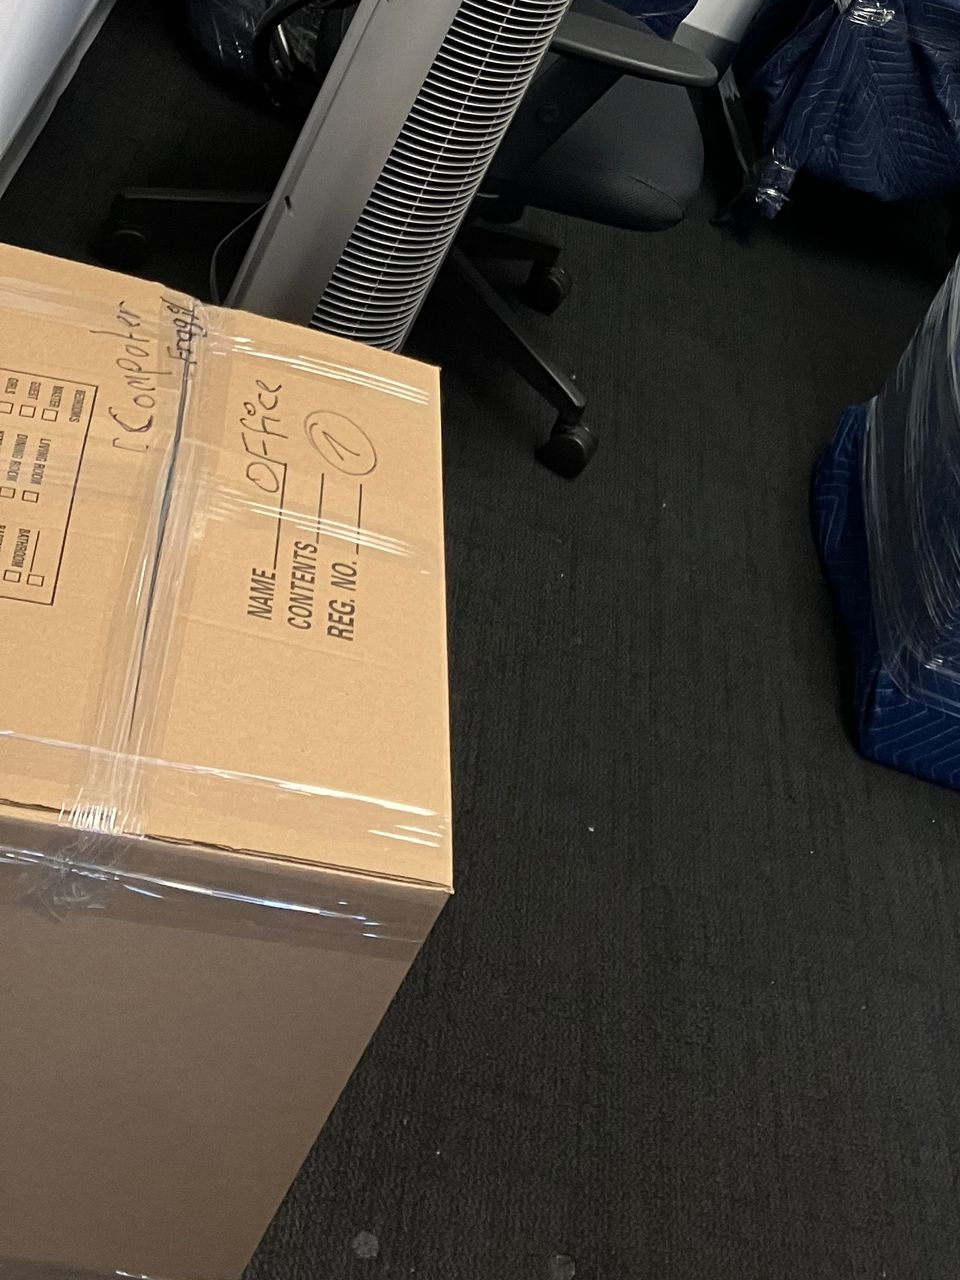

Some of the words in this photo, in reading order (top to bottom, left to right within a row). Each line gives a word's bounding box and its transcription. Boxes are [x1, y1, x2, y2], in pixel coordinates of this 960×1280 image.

[35, 438, 52, 463] LIVING
[30, 462, 46, 485] ROOM
[11, 528, 31, 568] BATHROOM
[247, 568, 276, 621] NAME
[287, 540, 318, 630] CONTENTS
[330, 561, 358, 592] NO.
[327, 599, 356, 642] REG.
